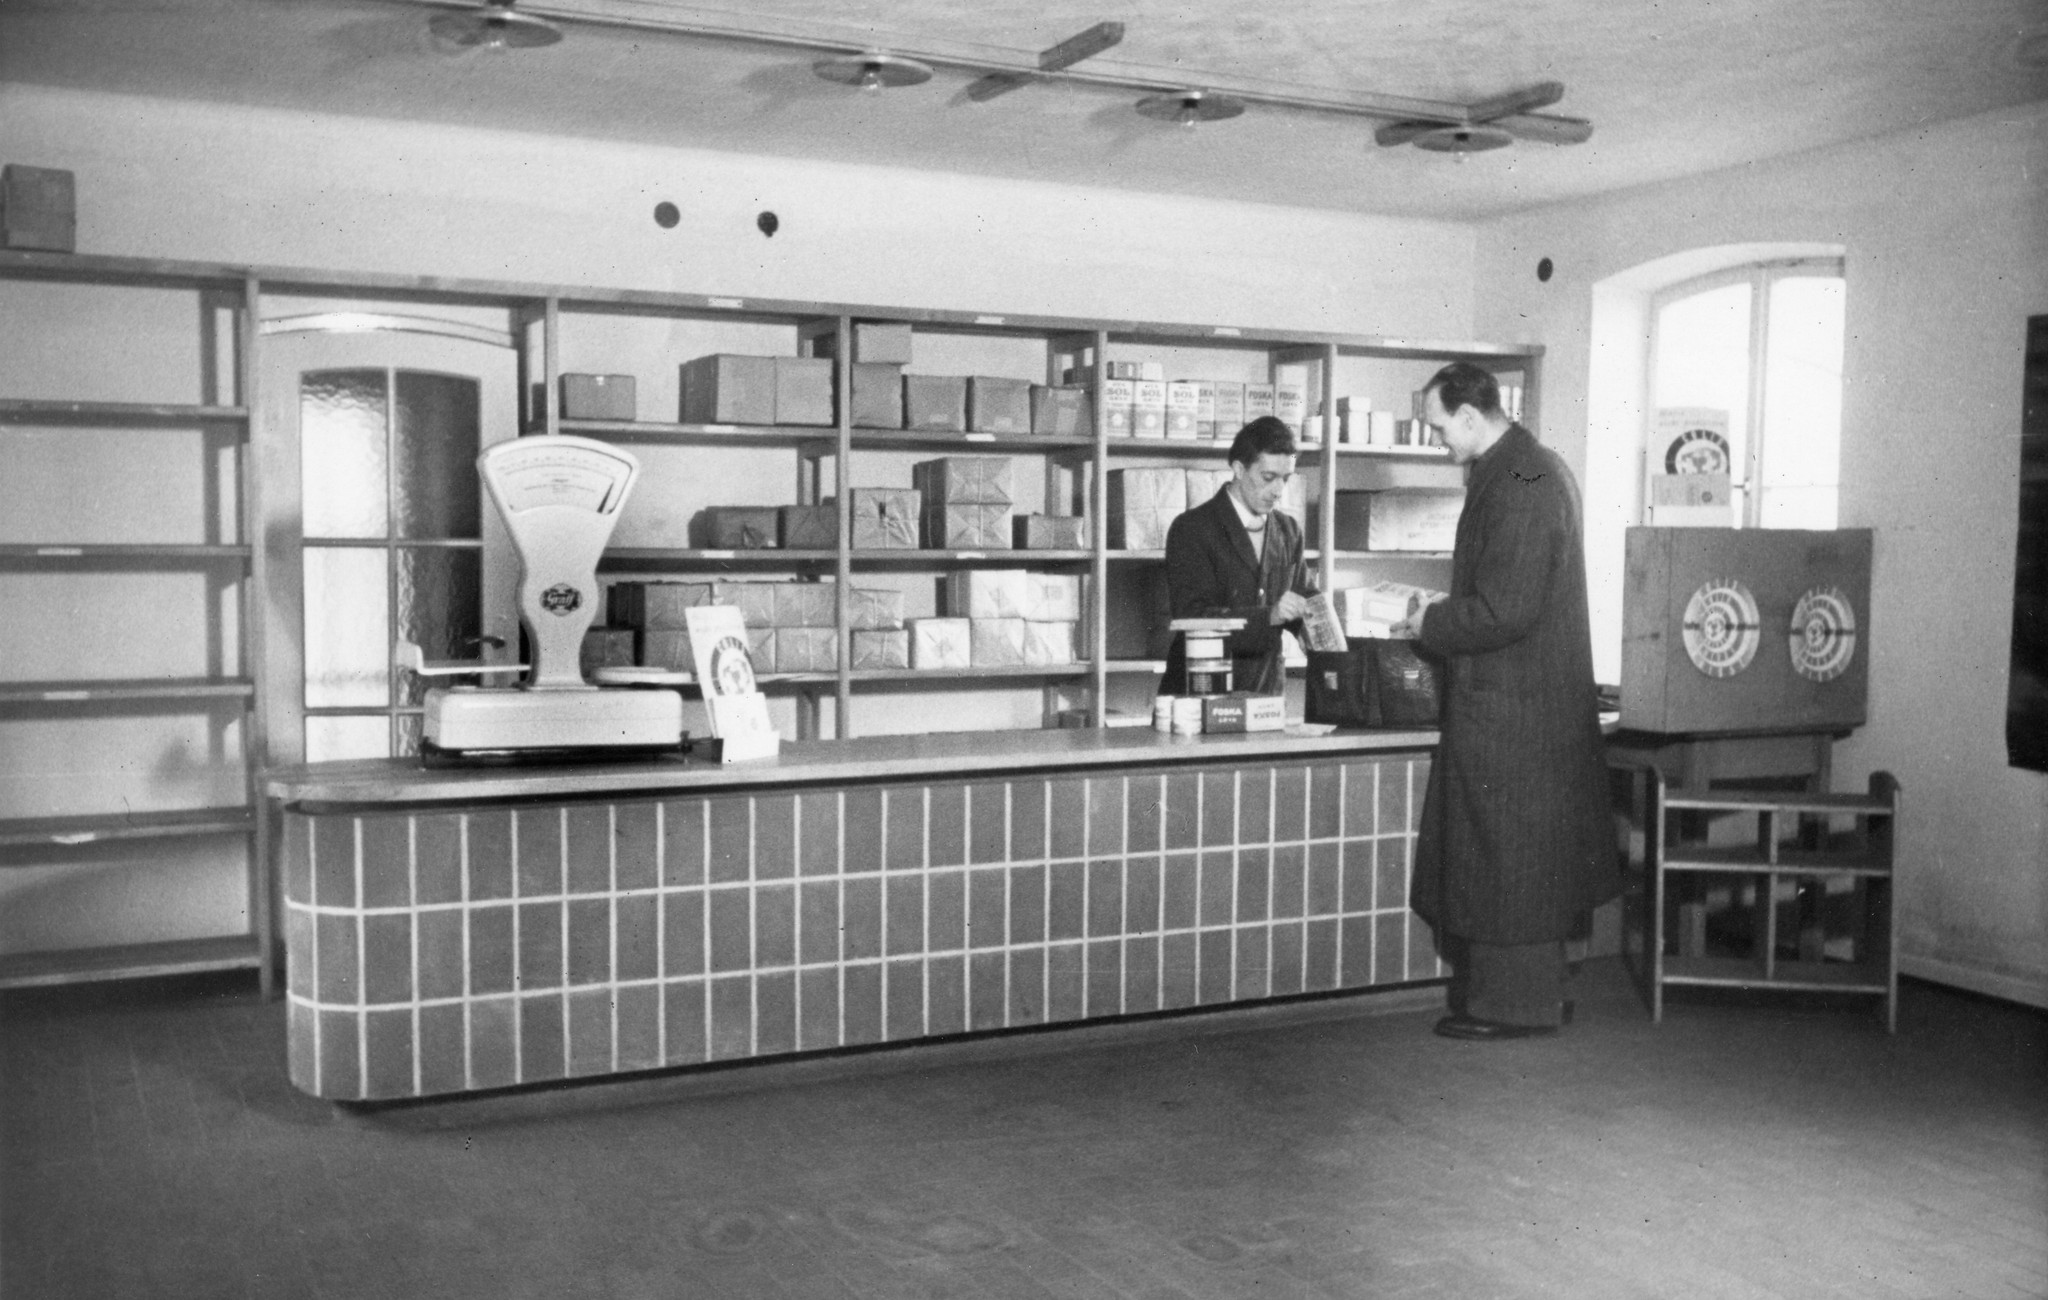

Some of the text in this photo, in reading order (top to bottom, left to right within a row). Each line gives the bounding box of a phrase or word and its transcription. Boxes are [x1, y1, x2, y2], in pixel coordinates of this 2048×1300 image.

[1141, 389, 1162, 397] SOL
[1248, 390, 1272, 399] FOSKA
[1212, 707, 1243, 716] FOSKA
